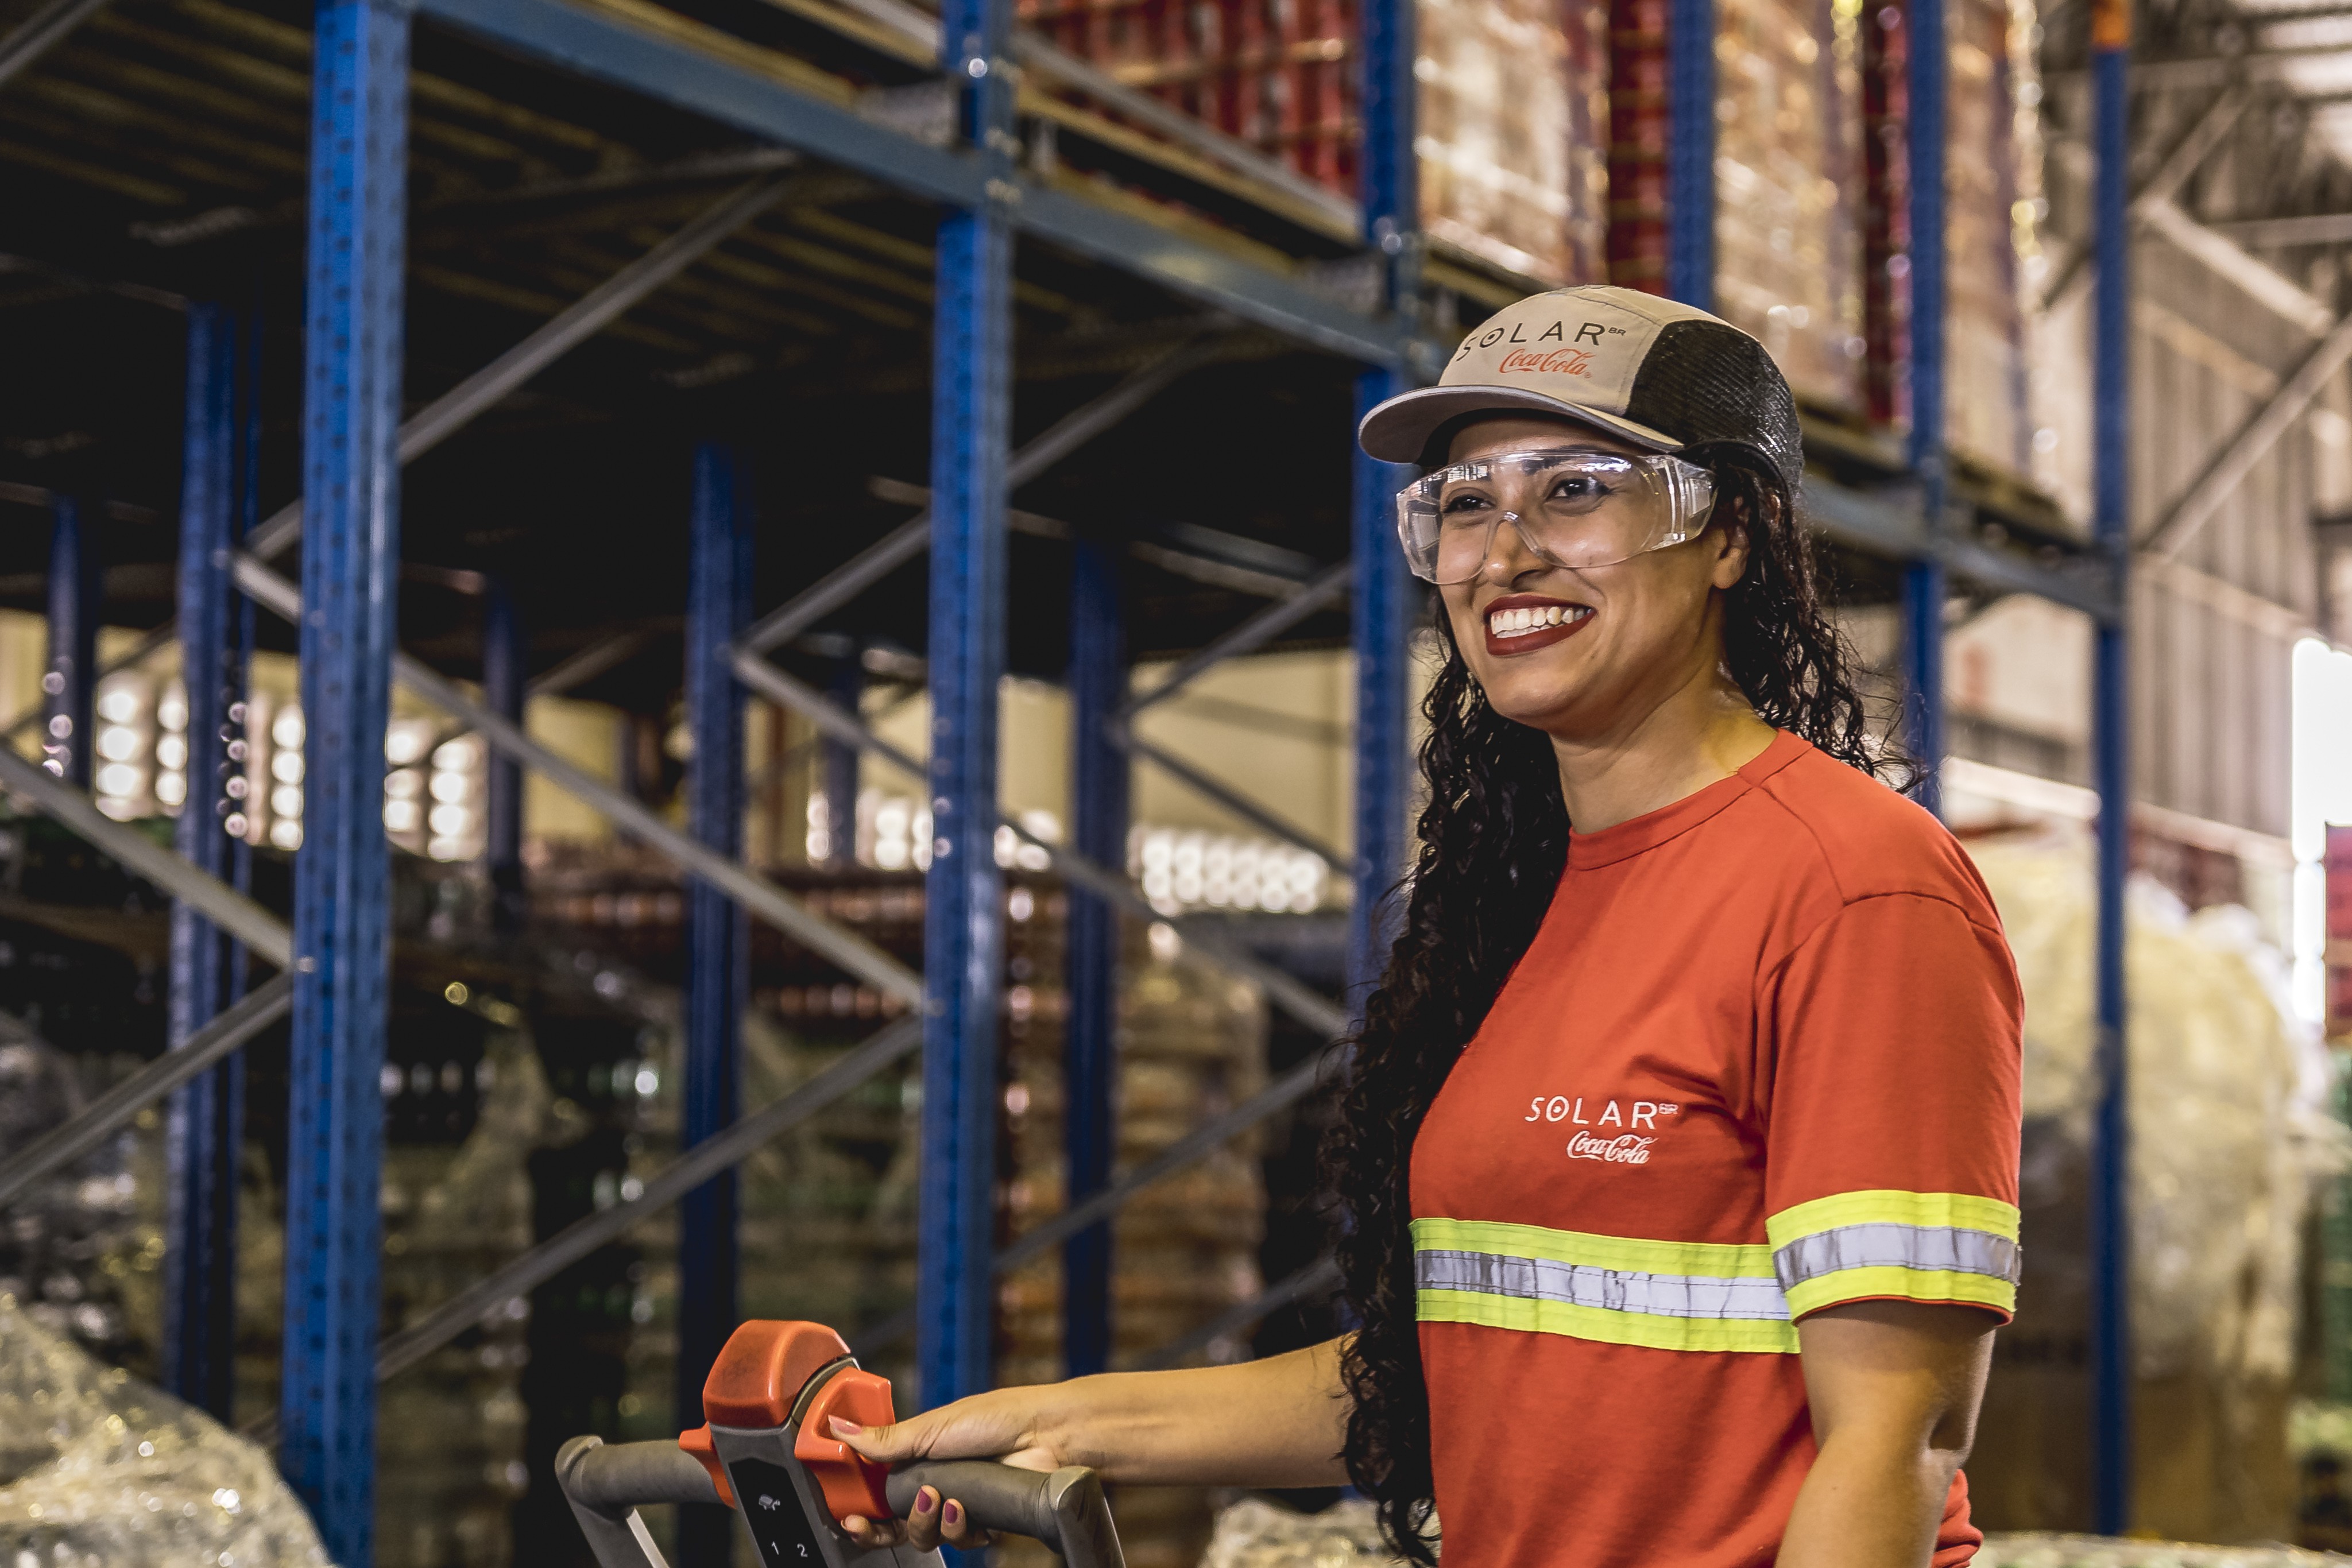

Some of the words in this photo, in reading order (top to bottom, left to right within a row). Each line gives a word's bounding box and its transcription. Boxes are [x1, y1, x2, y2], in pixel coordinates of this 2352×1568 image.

[1456, 320, 1606, 362] SOLAR
[1608, 327, 1627, 336] BR
[1525, 1095, 1657, 1129] SOLAR
[771, 1540, 779, 1555] 1
[796, 1543, 808, 1558] 2
